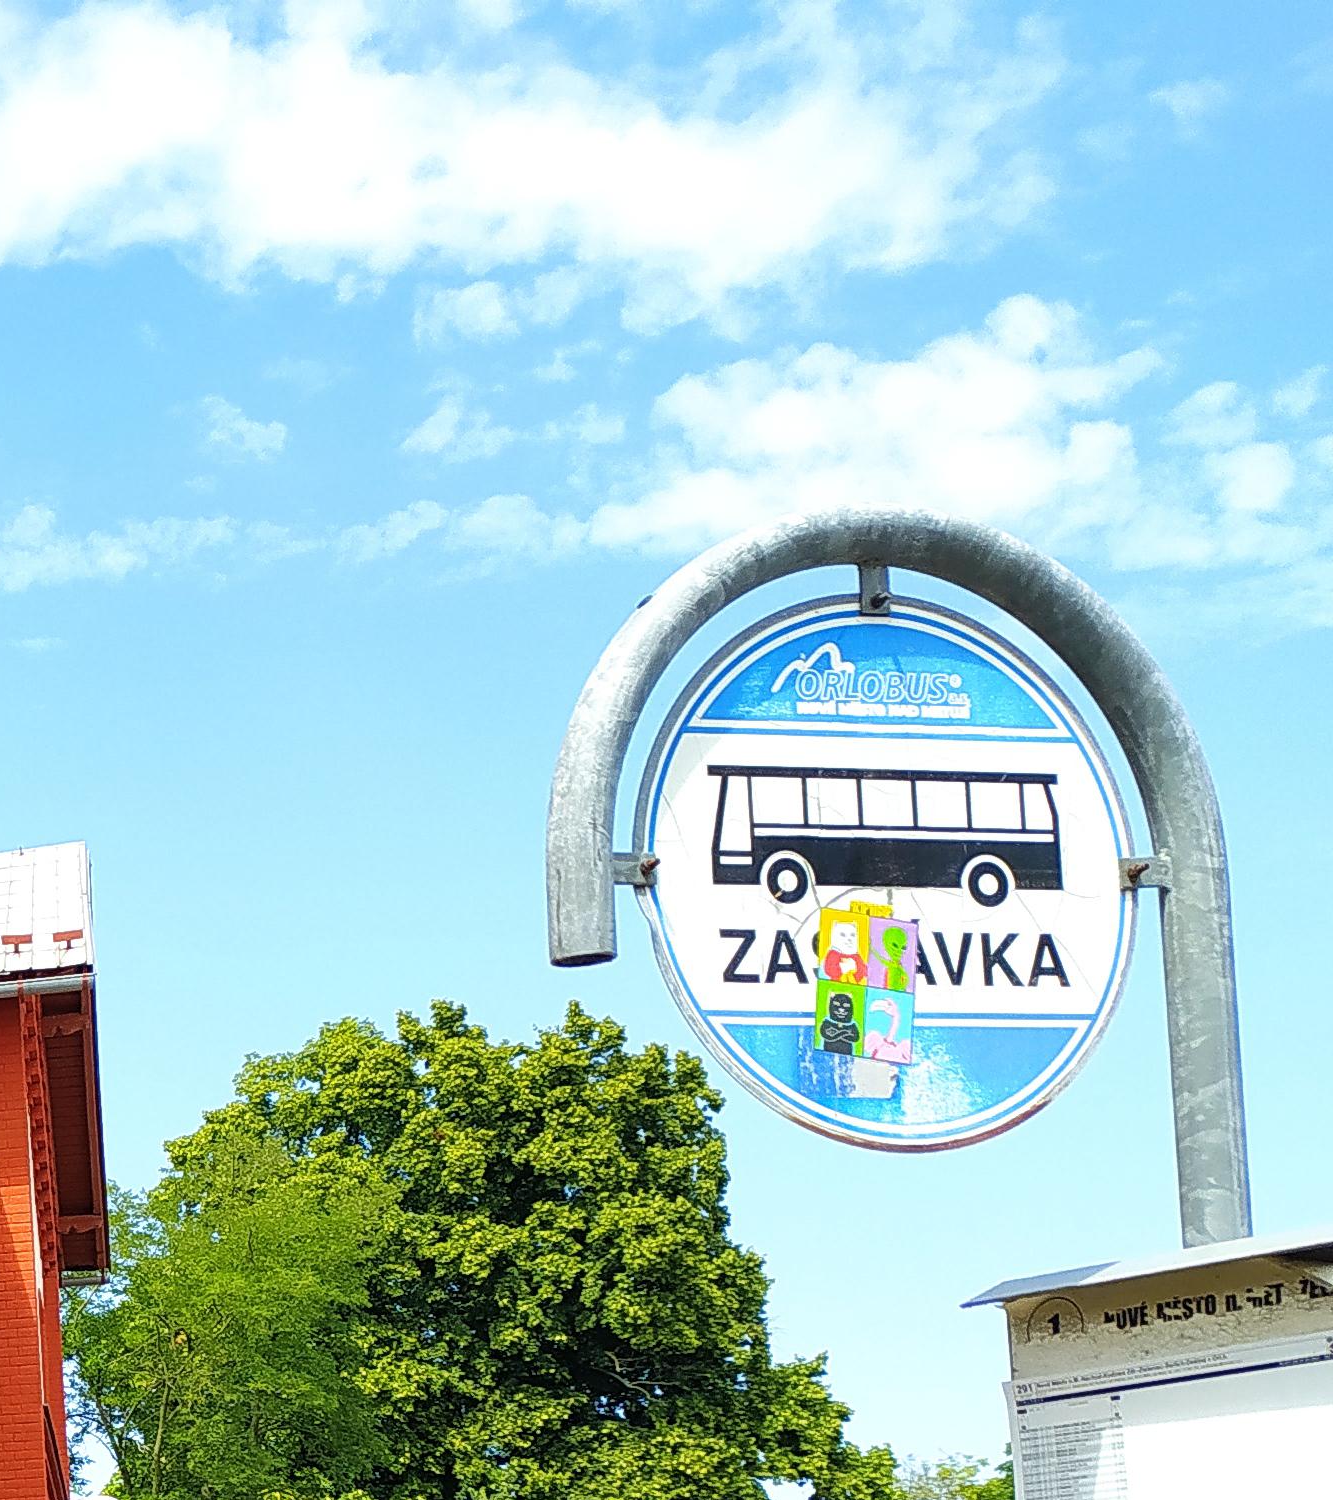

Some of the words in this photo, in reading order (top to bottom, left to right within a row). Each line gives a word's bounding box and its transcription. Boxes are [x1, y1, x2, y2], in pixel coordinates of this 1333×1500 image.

[795, 668, 950, 704] ORLOBUS
[719, 922, 1071, 987] ZAVKA
[1047, 1313, 1061, 1335] 1
